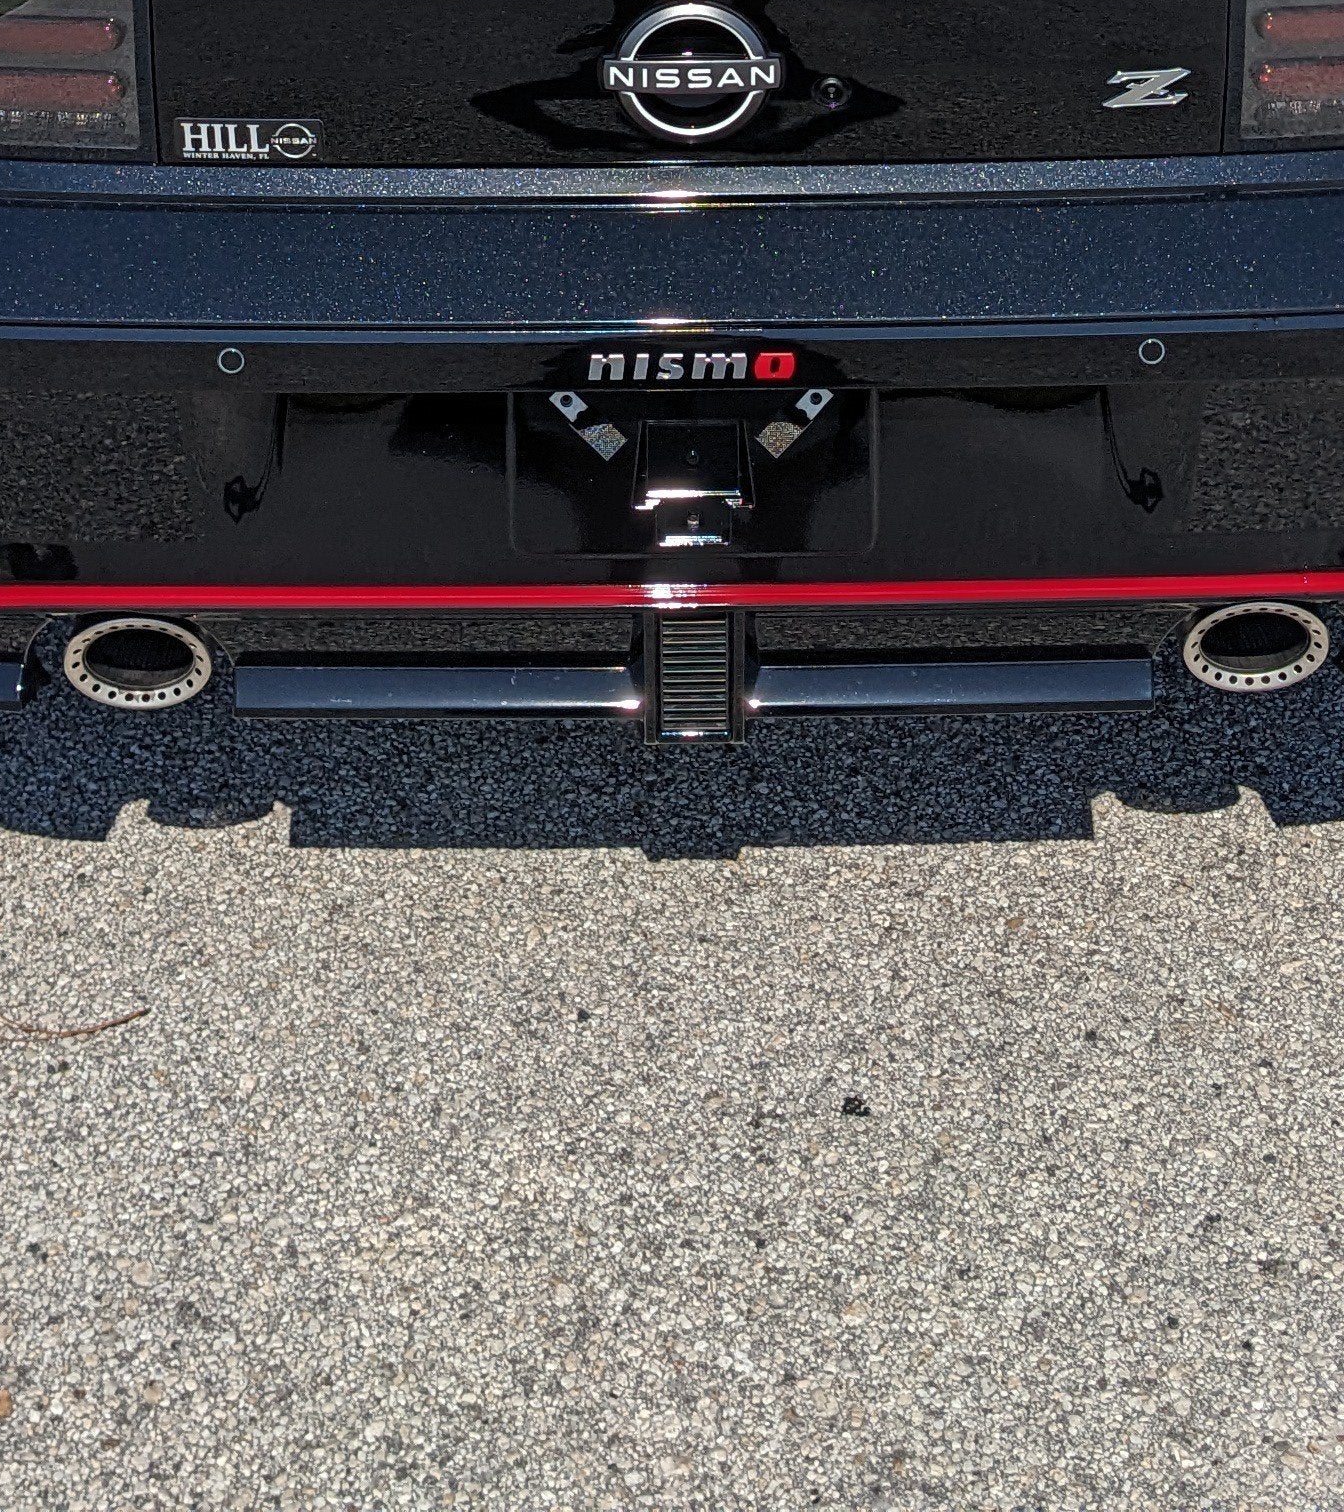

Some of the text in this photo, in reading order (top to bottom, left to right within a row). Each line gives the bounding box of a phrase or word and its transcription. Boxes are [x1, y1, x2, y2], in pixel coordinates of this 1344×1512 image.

[609, 65, 775, 89] NISSAN
[1102, 67, 1192, 109] Z
[180, 122, 318, 153] HILL NISSAN
[221, 152, 257, 160] HAVEN,
[258, 152, 270, 160] FL
[587, 352, 796, 381] nismo
